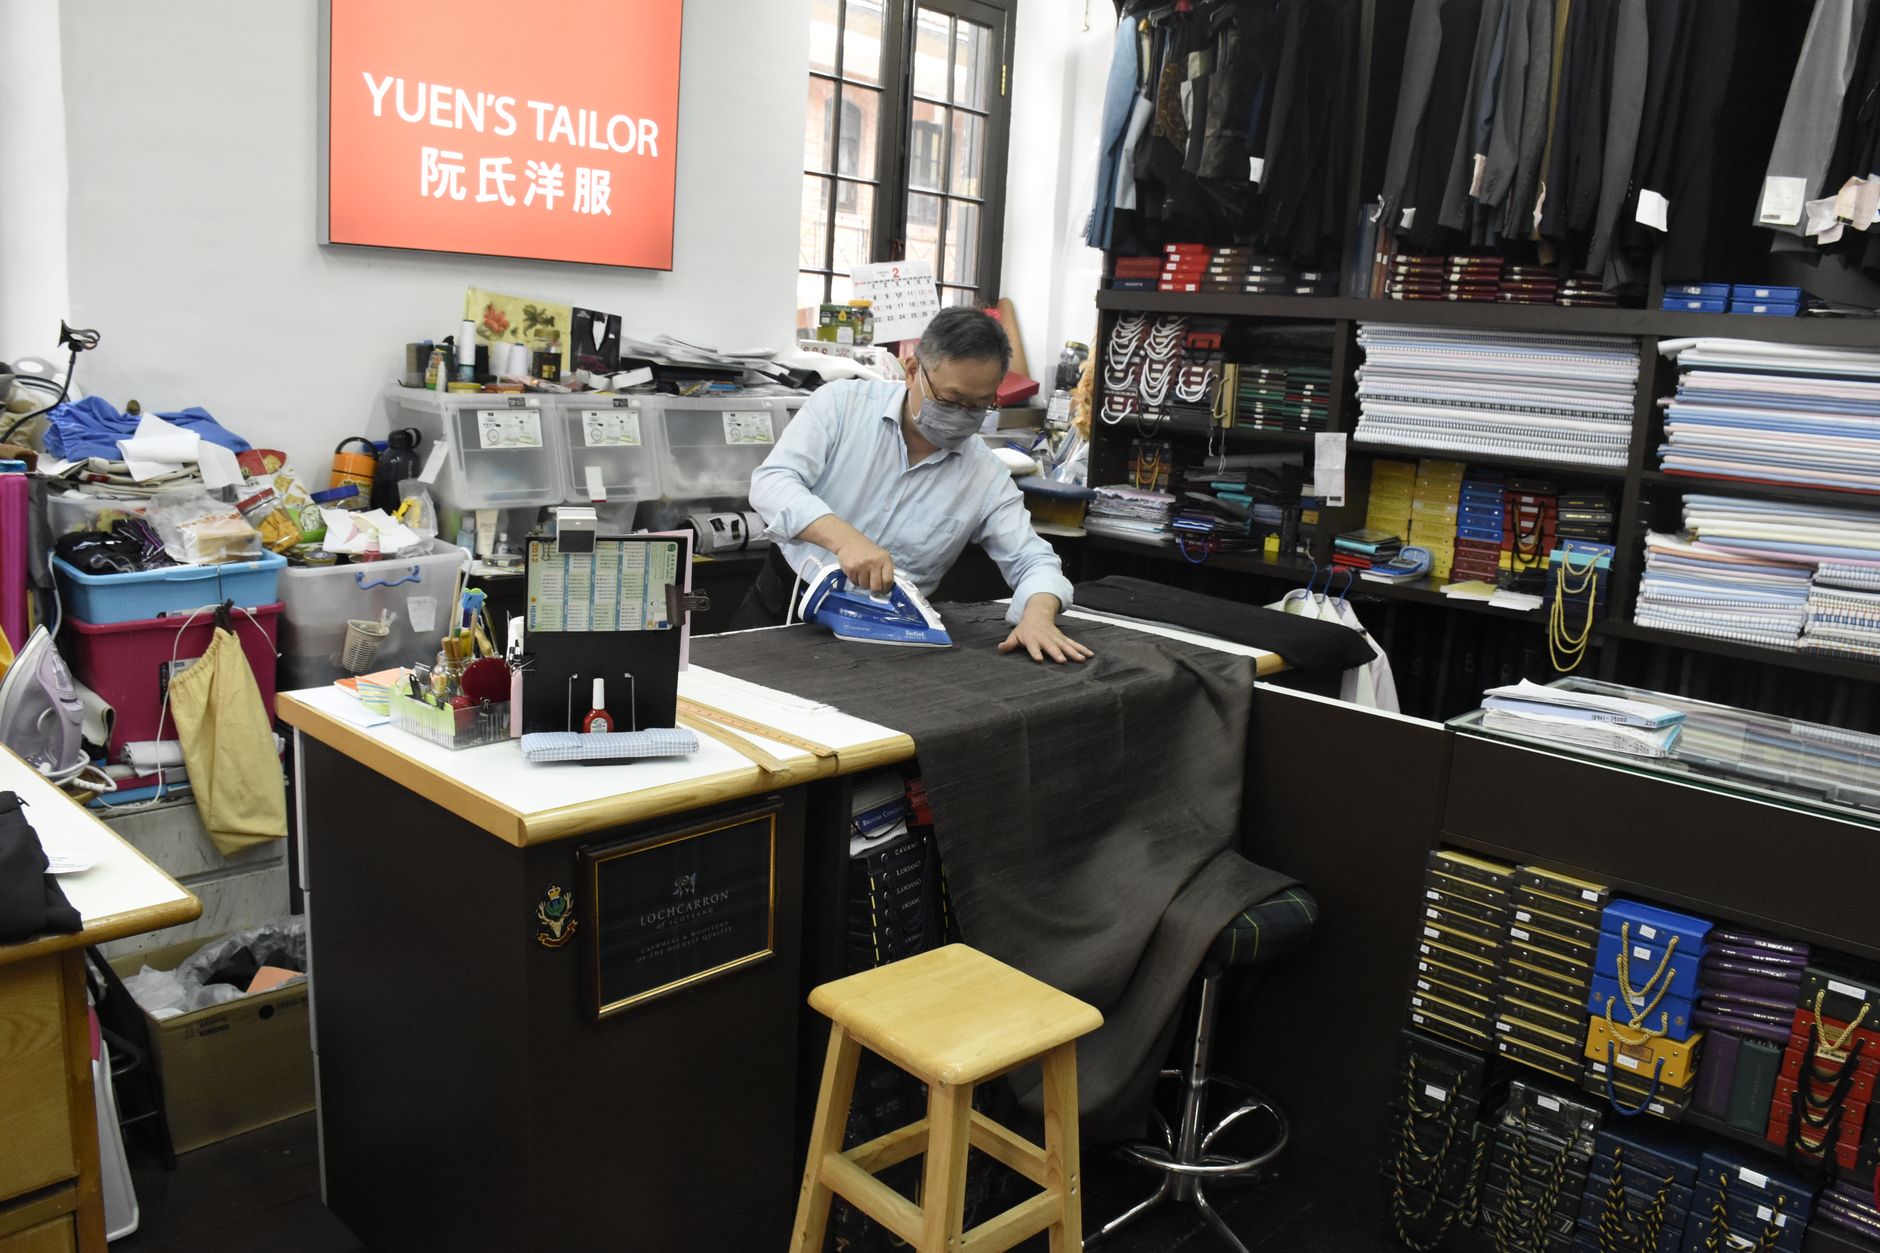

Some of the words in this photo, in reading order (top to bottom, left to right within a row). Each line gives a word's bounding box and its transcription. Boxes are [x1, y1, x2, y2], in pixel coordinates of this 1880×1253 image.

[362, 71, 517, 137] YUEN'S
[527, 100, 659, 157] TAILOR
[420, 146, 612, 216] 阮氏洋服
[892, 268, 900, 278] 2
[896, 860, 921, 876] LUCIANO
[897, 879, 921, 894] LUCIANO
[640, 890, 729, 926] LOCHCARRON
